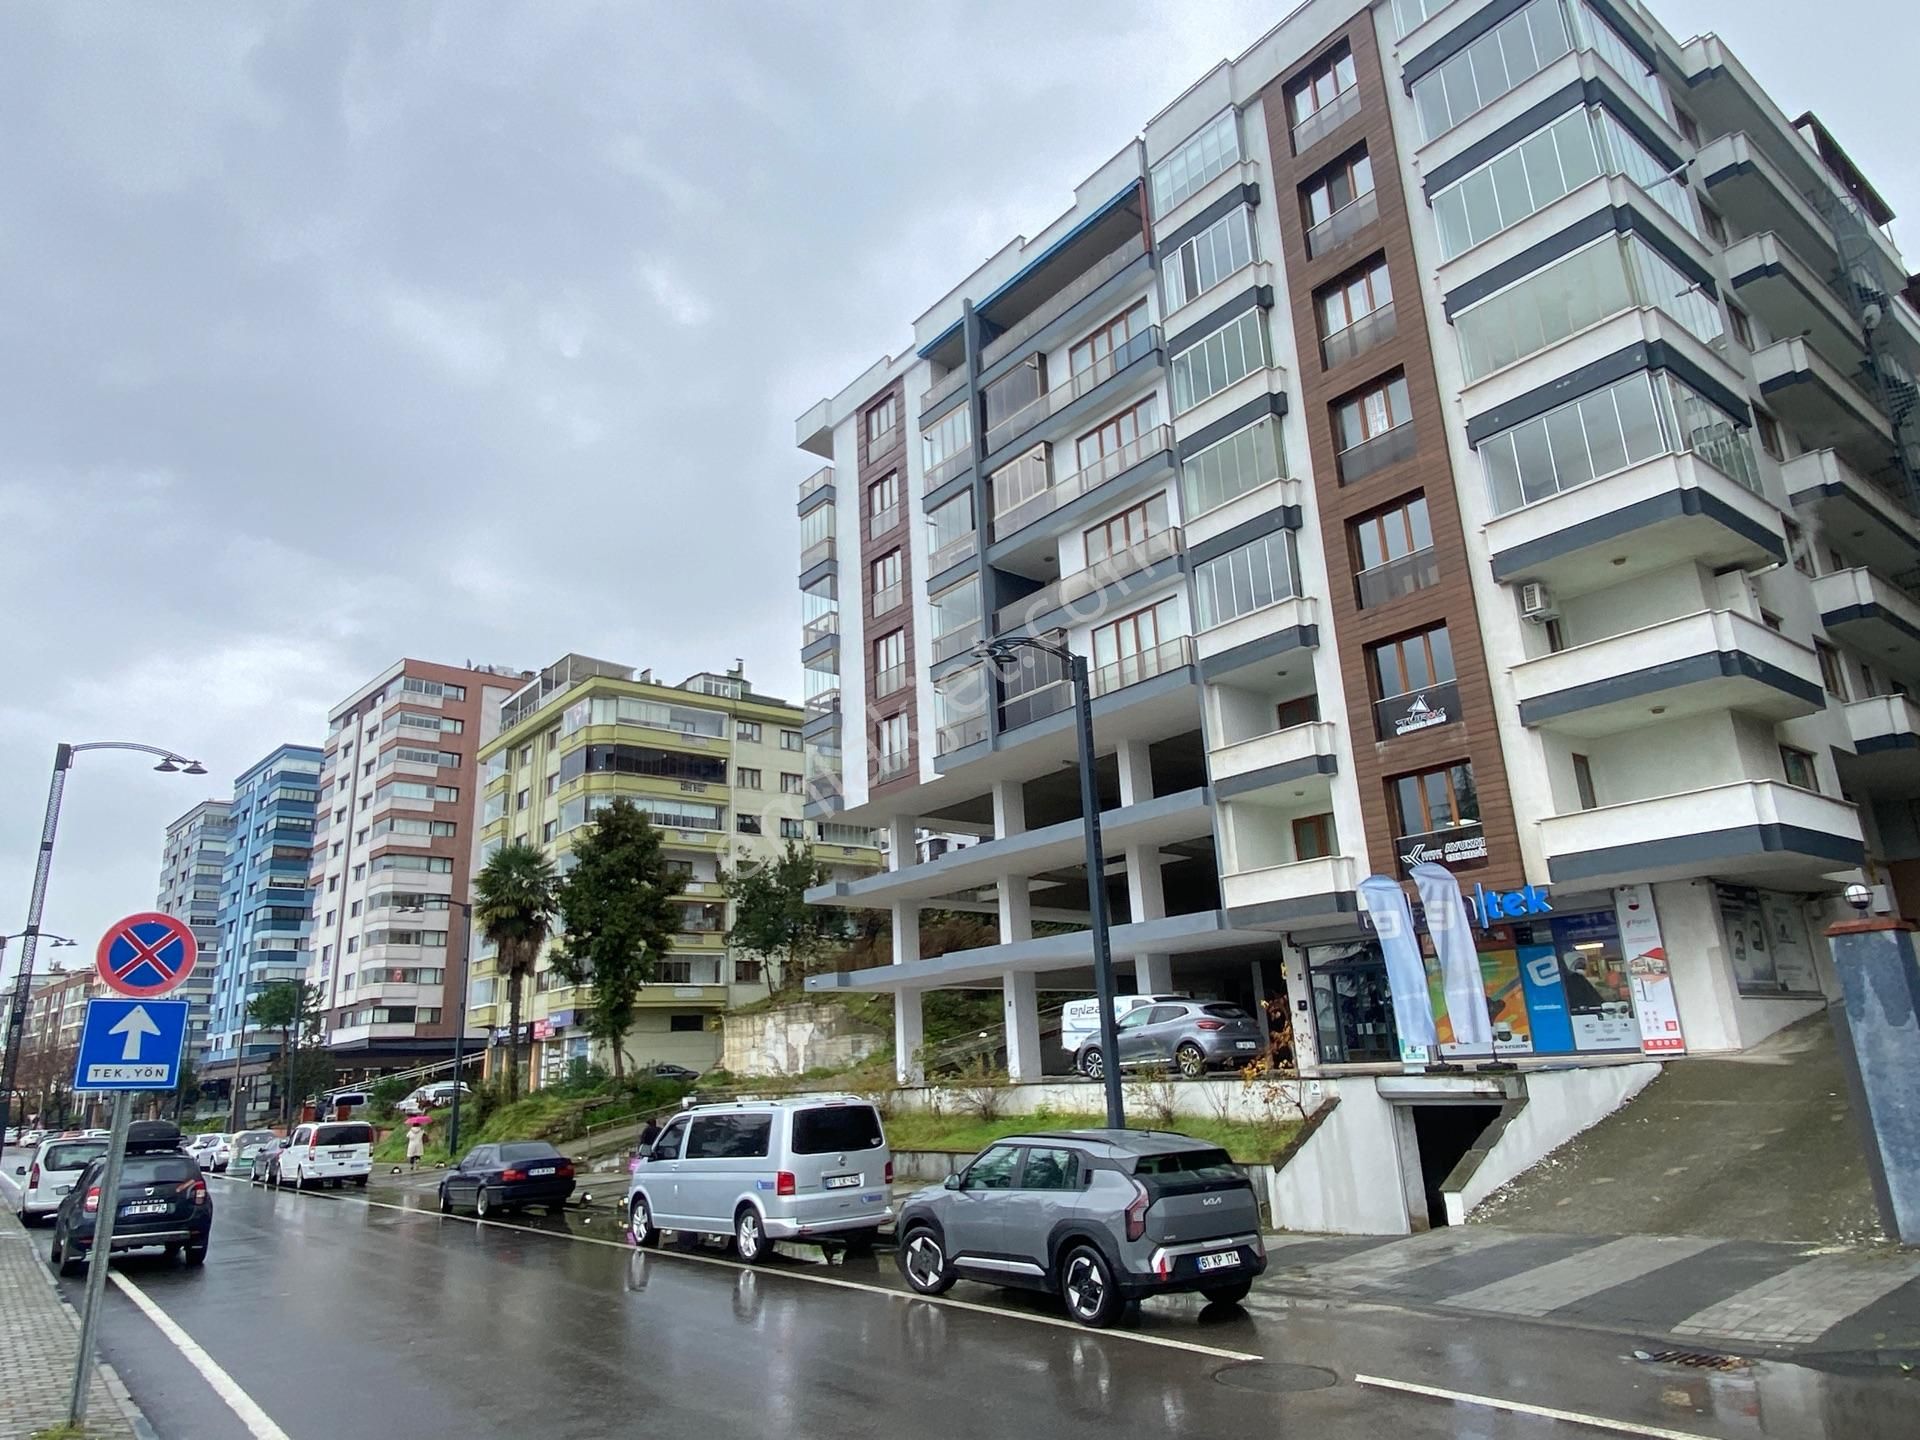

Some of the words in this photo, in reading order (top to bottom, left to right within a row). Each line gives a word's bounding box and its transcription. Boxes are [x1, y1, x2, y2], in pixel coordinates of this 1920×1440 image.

[93, 1068, 124, 1078] TEK
[134, 1067, 165, 1077] YÖN
[1201, 1257, 1210, 1268] 61
[1212, 1255, 1222, 1266] KP
[1225, 1252, 1239, 1264] 174
